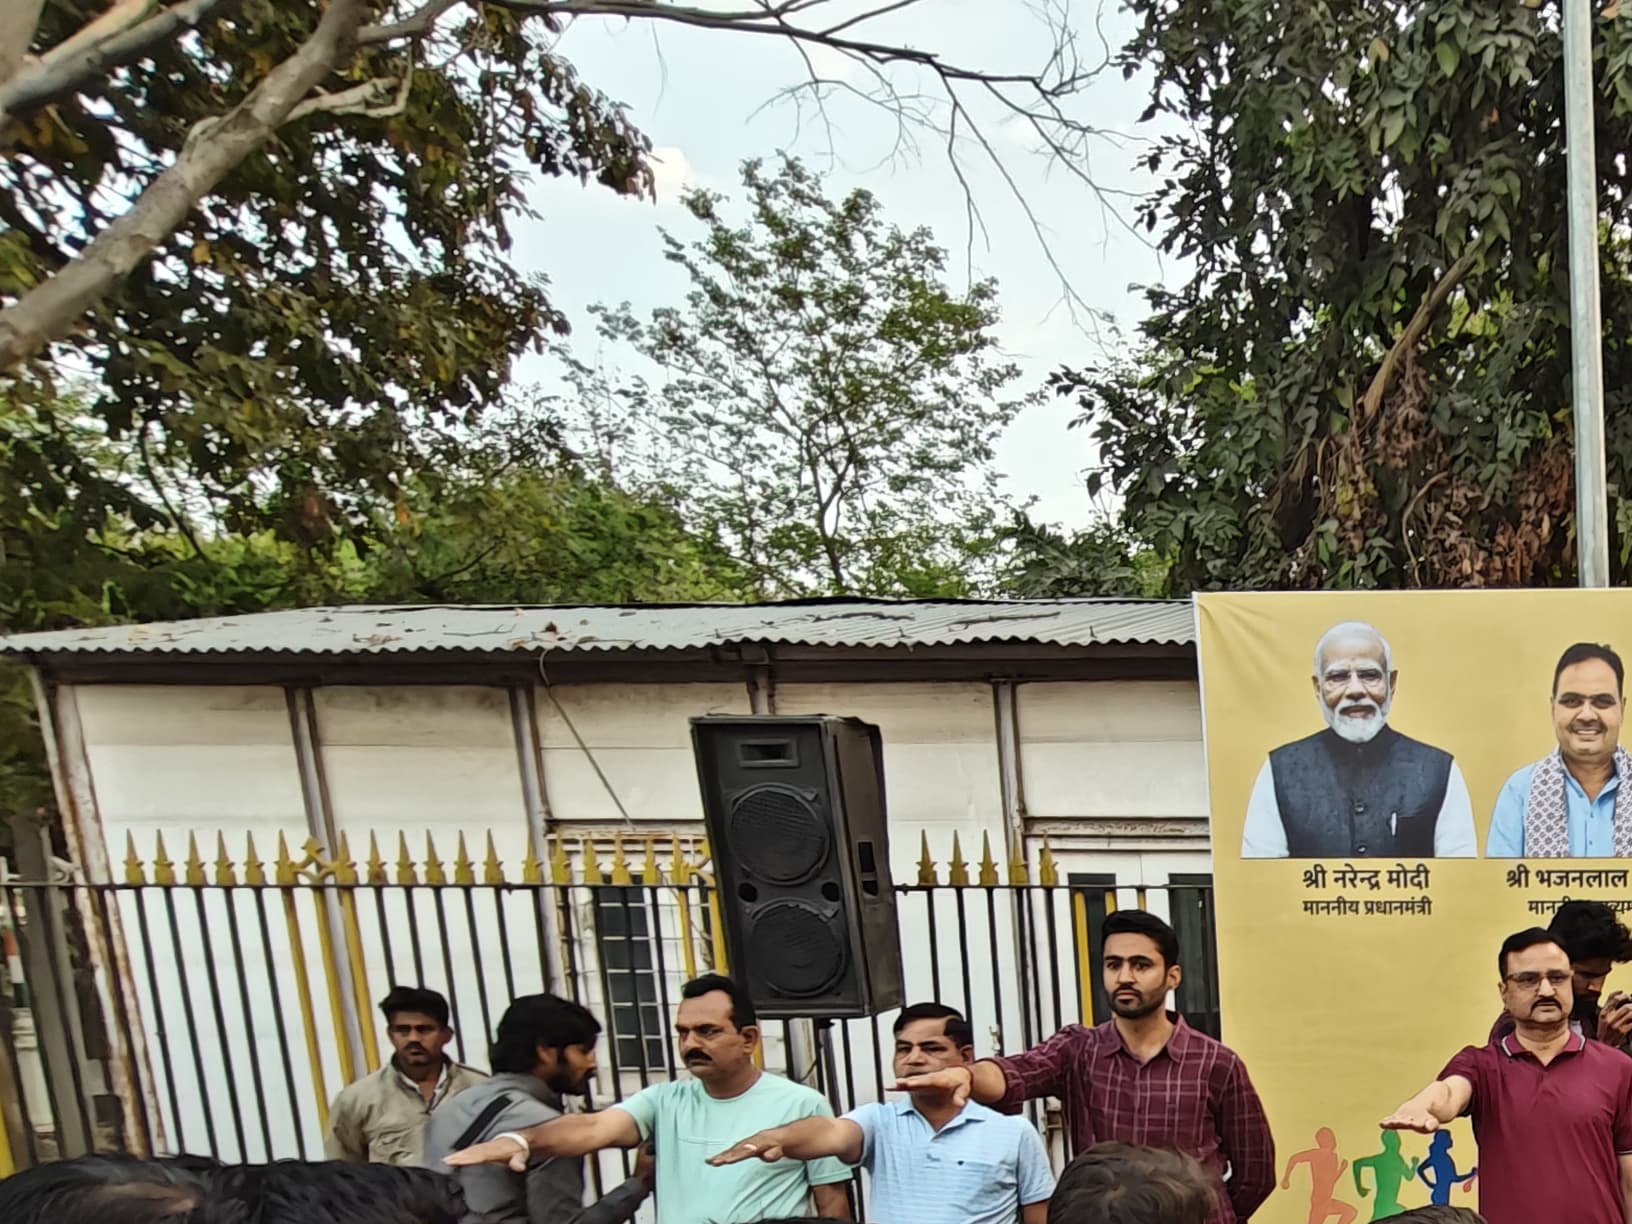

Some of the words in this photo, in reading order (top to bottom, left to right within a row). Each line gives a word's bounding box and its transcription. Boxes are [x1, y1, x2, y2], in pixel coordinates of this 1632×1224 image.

[1303, 864, 1327, 888] श्री
[1333, 863, 1381, 890] नरेन्द्र
[1387, 863, 1430, 889] मोदी
[1506, 864, 1530, 888] श्री
[1536, 869, 1628, 888] भजनलाल
[1303, 896, 1360, 915] माननीय
[1364, 896, 1432, 915] प्रधानमंत्री
